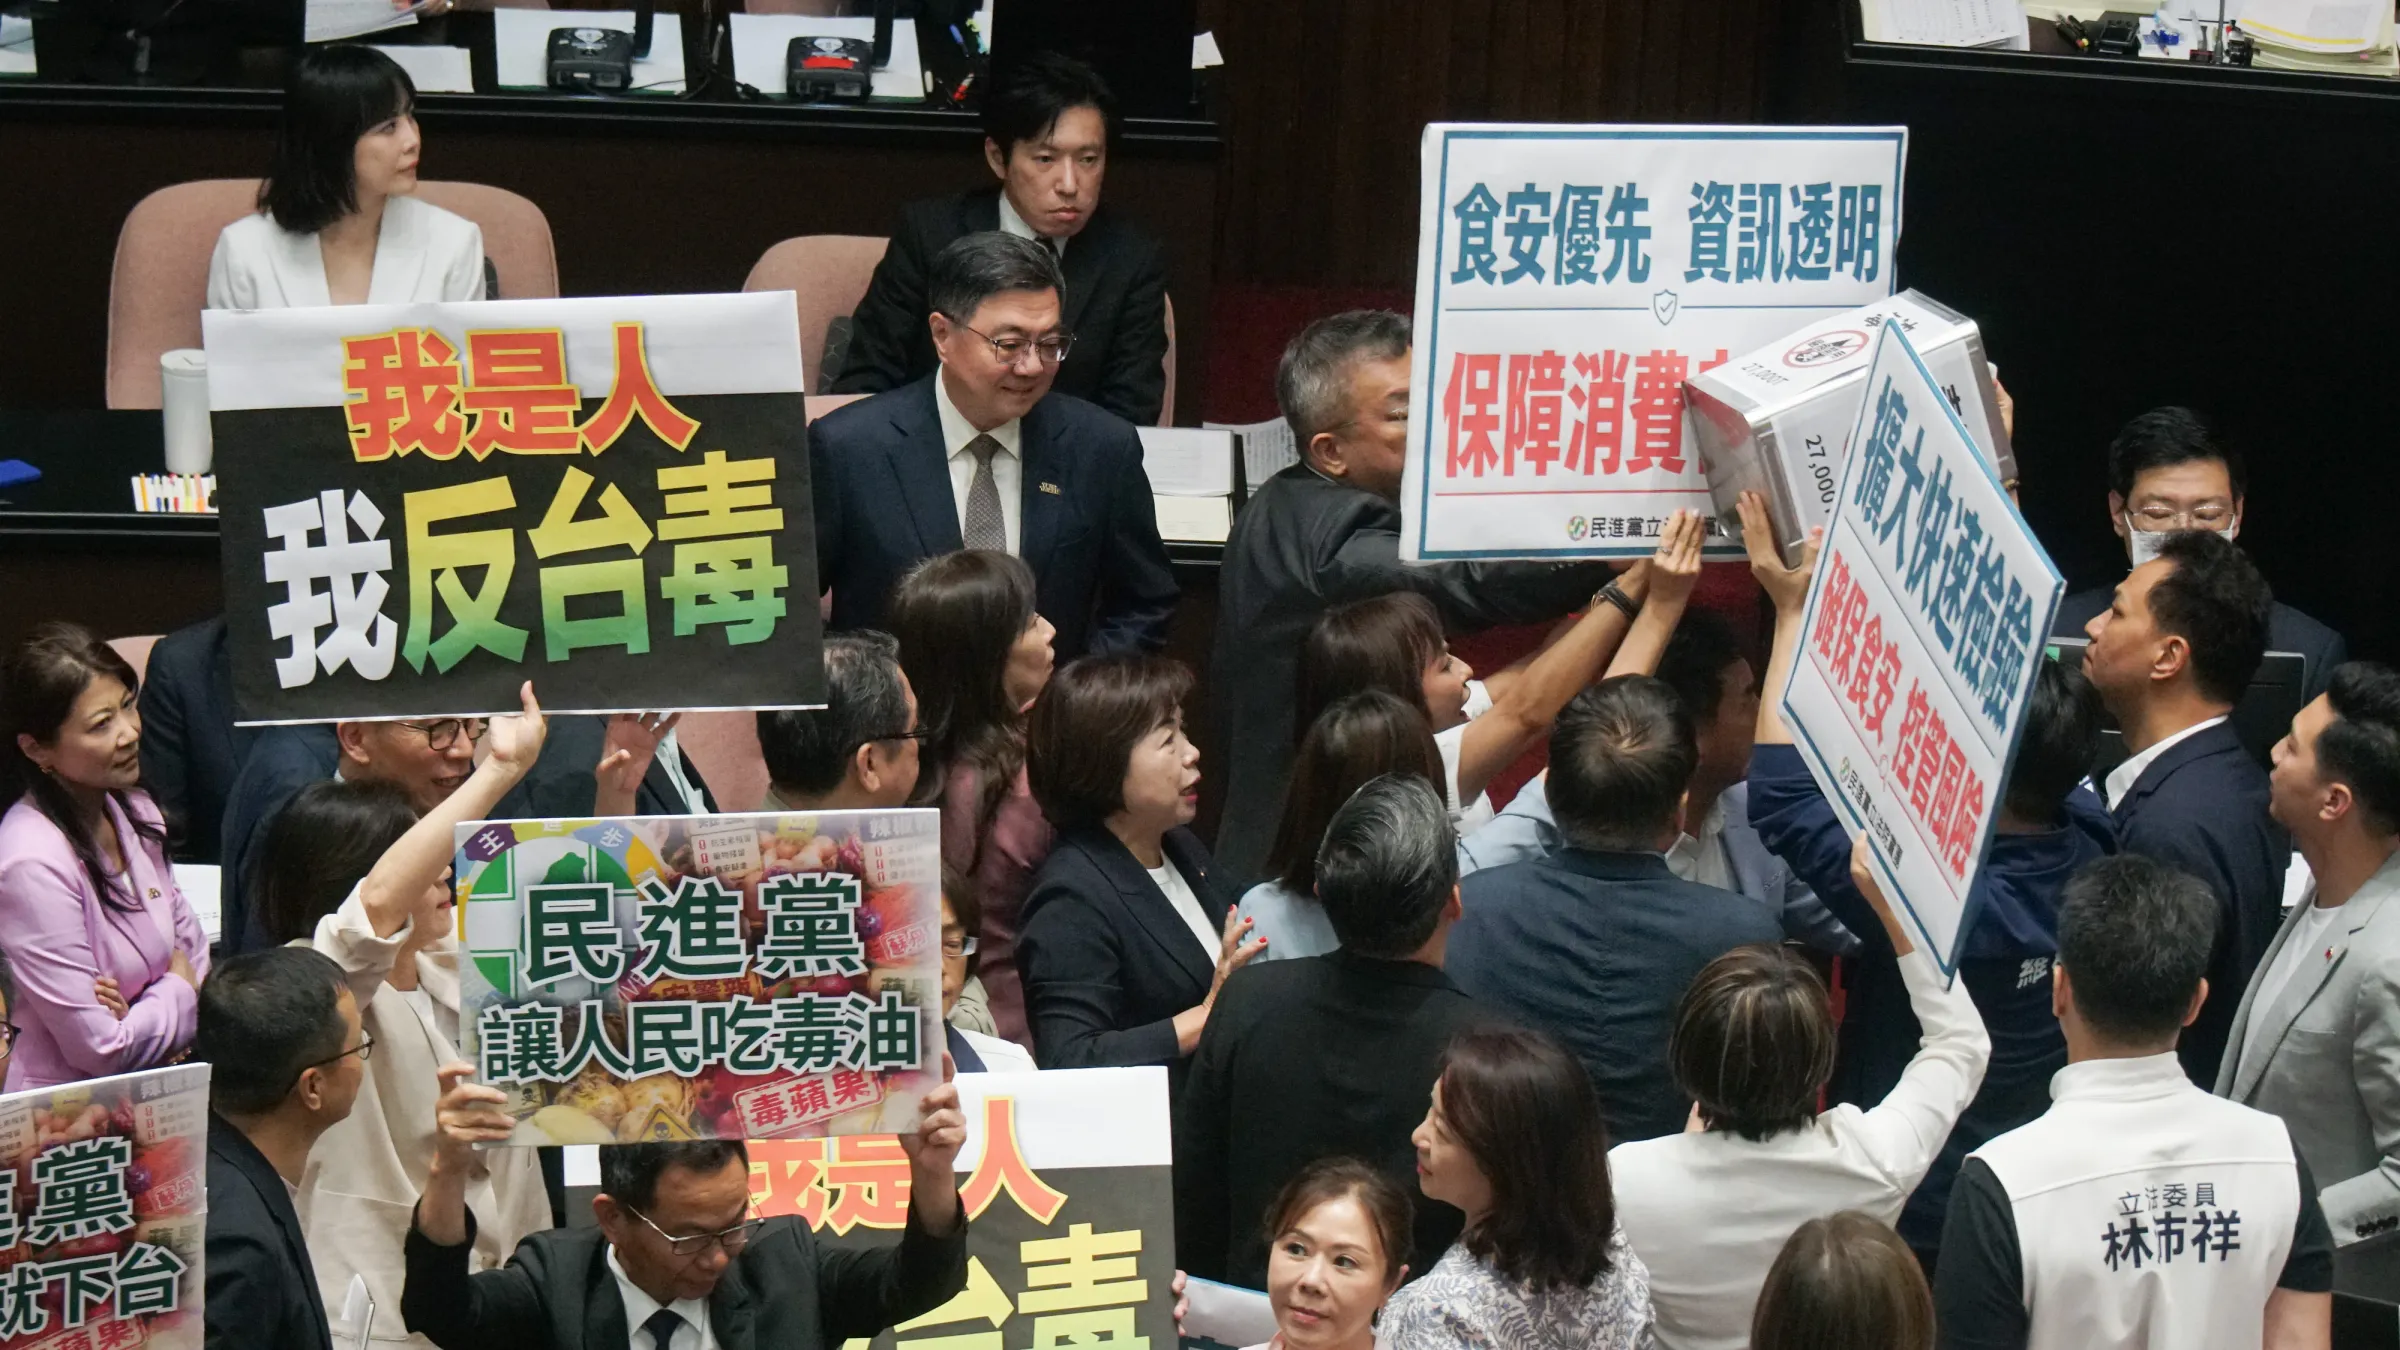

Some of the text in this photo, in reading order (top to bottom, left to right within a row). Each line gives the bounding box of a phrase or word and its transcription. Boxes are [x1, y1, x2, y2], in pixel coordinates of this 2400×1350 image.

[1450, 181, 1884, 286] 食安優先 資訊透明
[341, 321, 701, 462] 我是人
[1442, 349, 1729, 478] 保障消費
[1805, 434, 1836, 514] 27,000
[263, 450, 789, 689] 我反台毒
[1854, 374, 2034, 736] 擴大快速檢驗
[1813, 549, 1984, 882] 確保食安 控管風險
[522, 873, 868, 989] 民進黨
[478, 991, 922, 1085] 讓人民吃毒油
[749, 1070, 875, 1129] 毒蘋果
[0, 1135, 137, 1250] 黨
